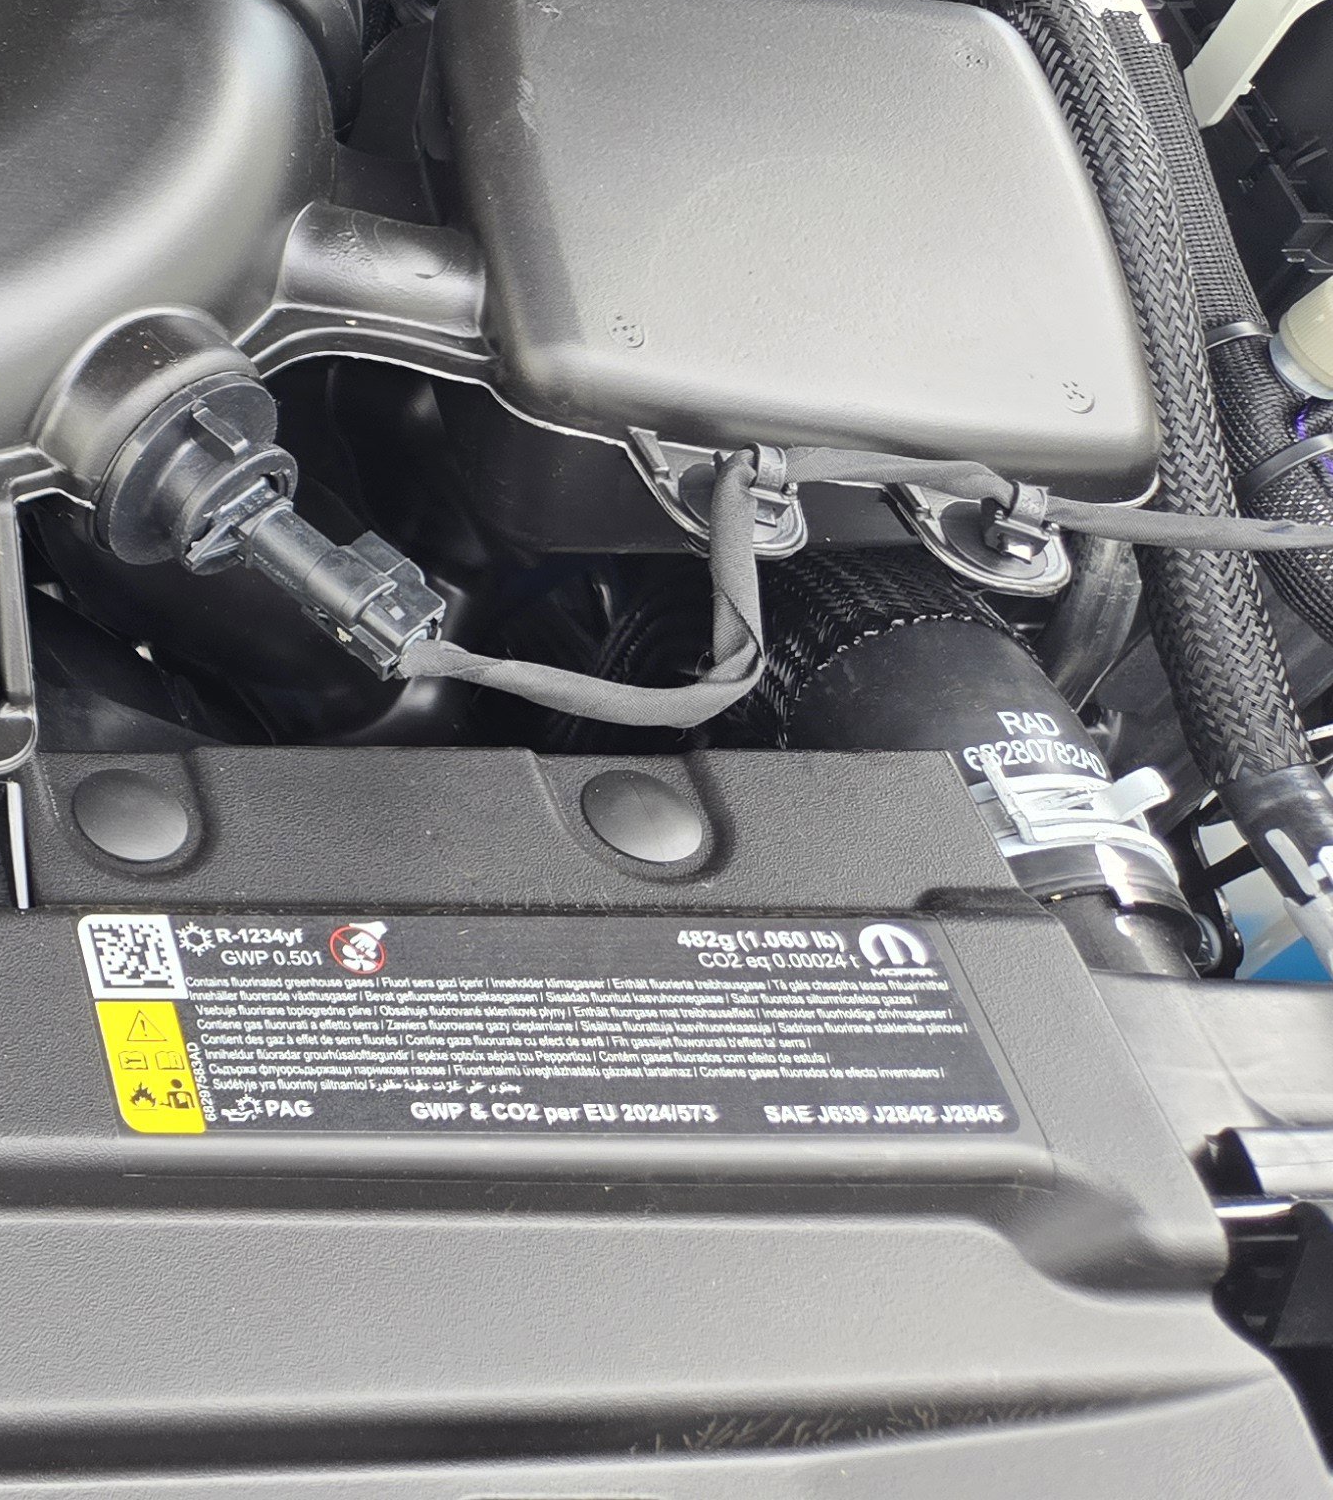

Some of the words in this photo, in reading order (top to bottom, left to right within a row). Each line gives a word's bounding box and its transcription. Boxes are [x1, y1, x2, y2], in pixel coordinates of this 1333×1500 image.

[997, 711, 1060, 737] RAD
[213, 928, 305, 945] R-1234yf
[673, 930, 738, 950] 482g
[734, 930, 812, 950] (1.060
[809, 930, 848, 950] lb)
[219, 950, 270, 965] GWP
[271, 950, 322, 965] 0.501
[696, 952, 743, 968] CO2
[744, 956, 771, 969] eq
[770, 952, 849, 968] 0.00024
[848, 954, 860, 968] t
[183, 975, 229, 987] Contains
[186, 1041, 218, 1123] 68297583AD
[263, 1100, 316, 1118] PAG
[409, 1101, 465, 1120] GWP
[468, 1102, 488, 1120] &
[490, 1102, 540, 1120] CO2
[543, 1107, 583, 1122] per
[582, 1103, 617, 1121] EU
[619, 1103, 718, 1122] 2024/573
[762, 1104, 816, 1123] SAE
[813, 1105, 872, 1123] J639
[868, 1104, 939, 1123] J2842
[936, 1104, 1007, 1123] J2845
